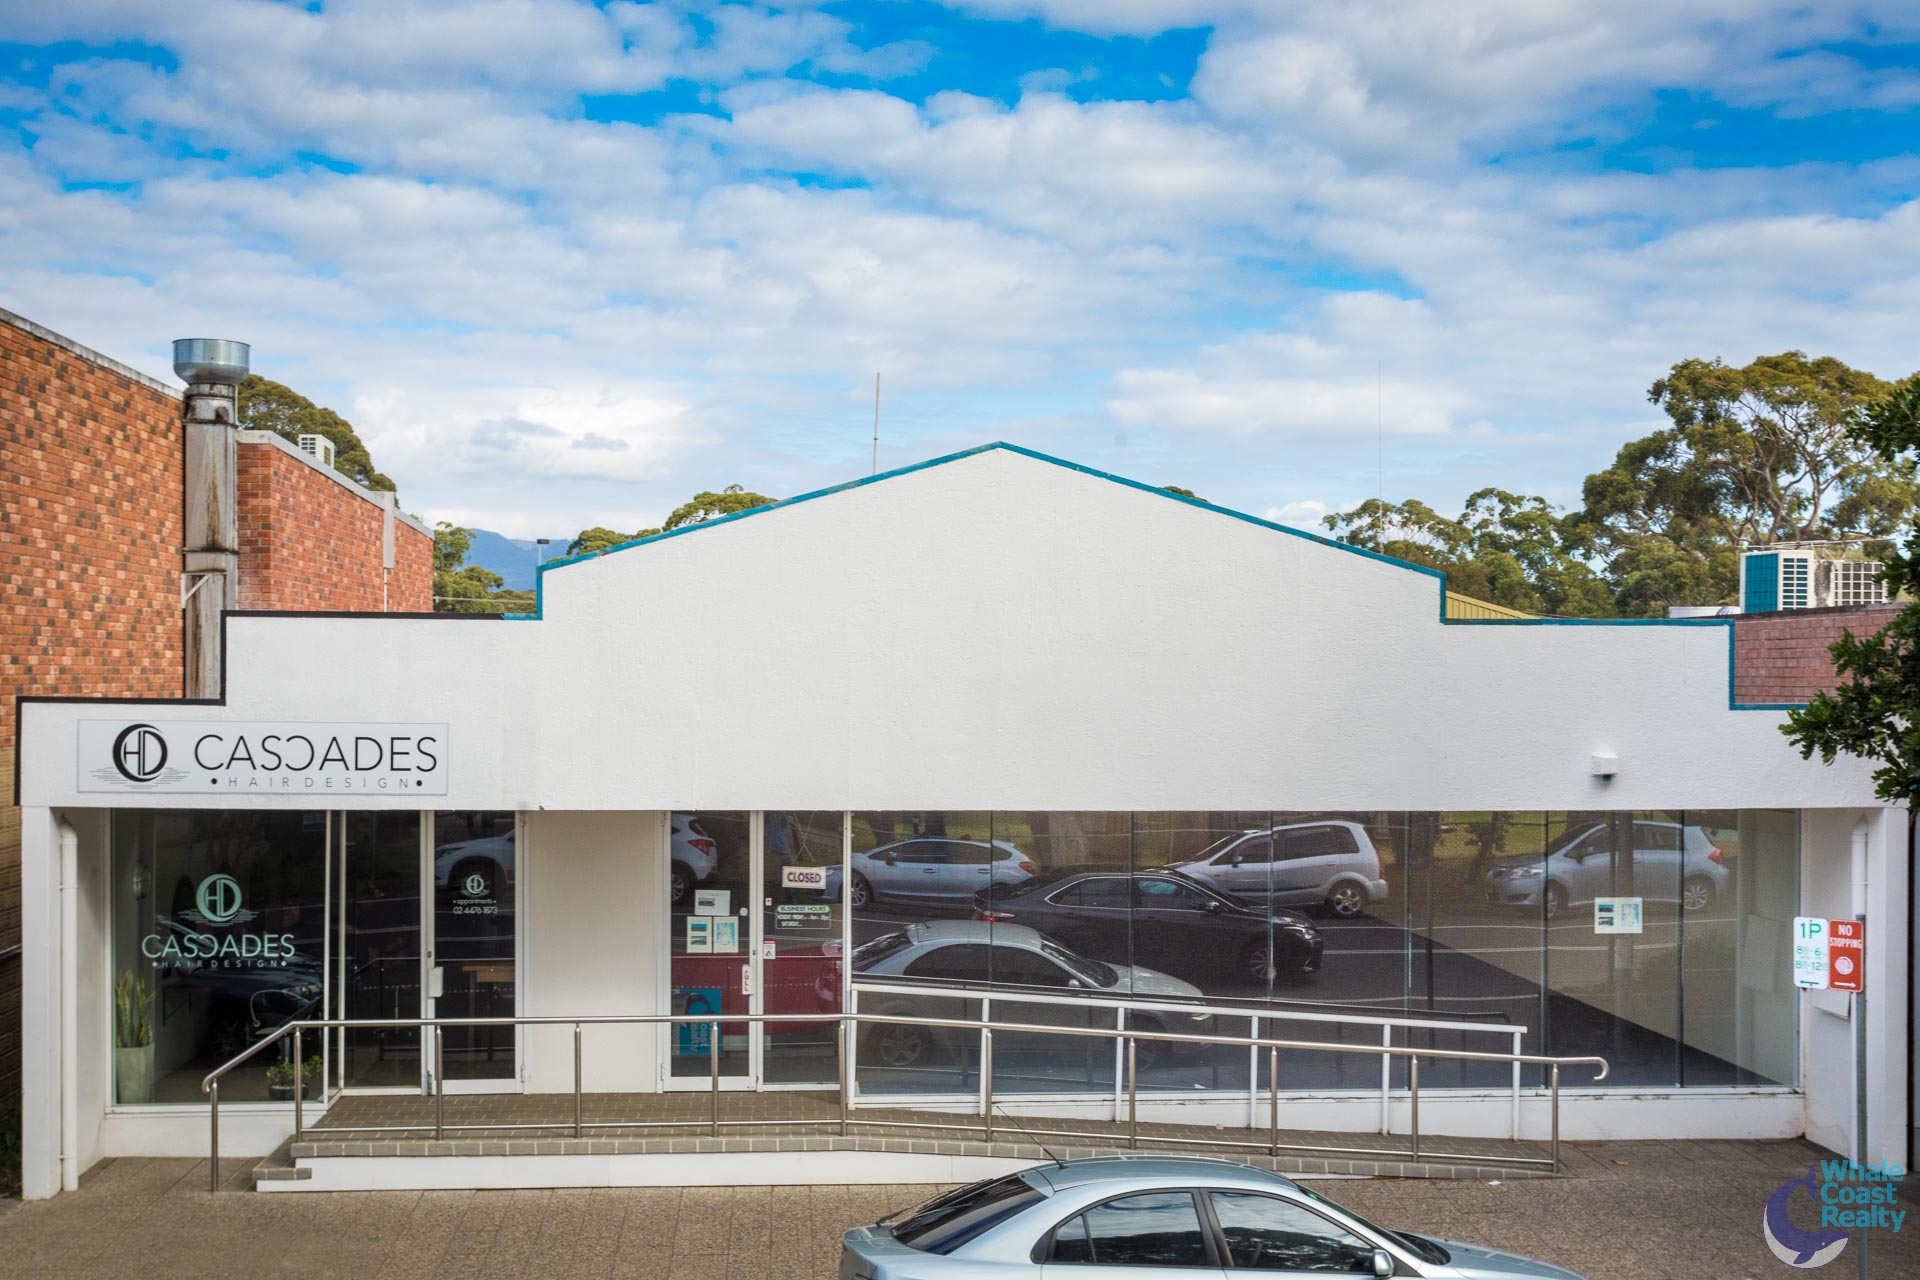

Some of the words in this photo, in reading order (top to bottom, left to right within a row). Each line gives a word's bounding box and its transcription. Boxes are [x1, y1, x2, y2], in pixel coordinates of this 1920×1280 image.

[195, 734, 438, 772] CASCADES
[787, 872, 822, 883] CLOSED
[1801, 922, 1822, 939] 1P
[1838, 925, 1853, 936] NO
[142, 934, 295, 958] CASCADES
[1829, 937, 1863, 949] STOPPING
